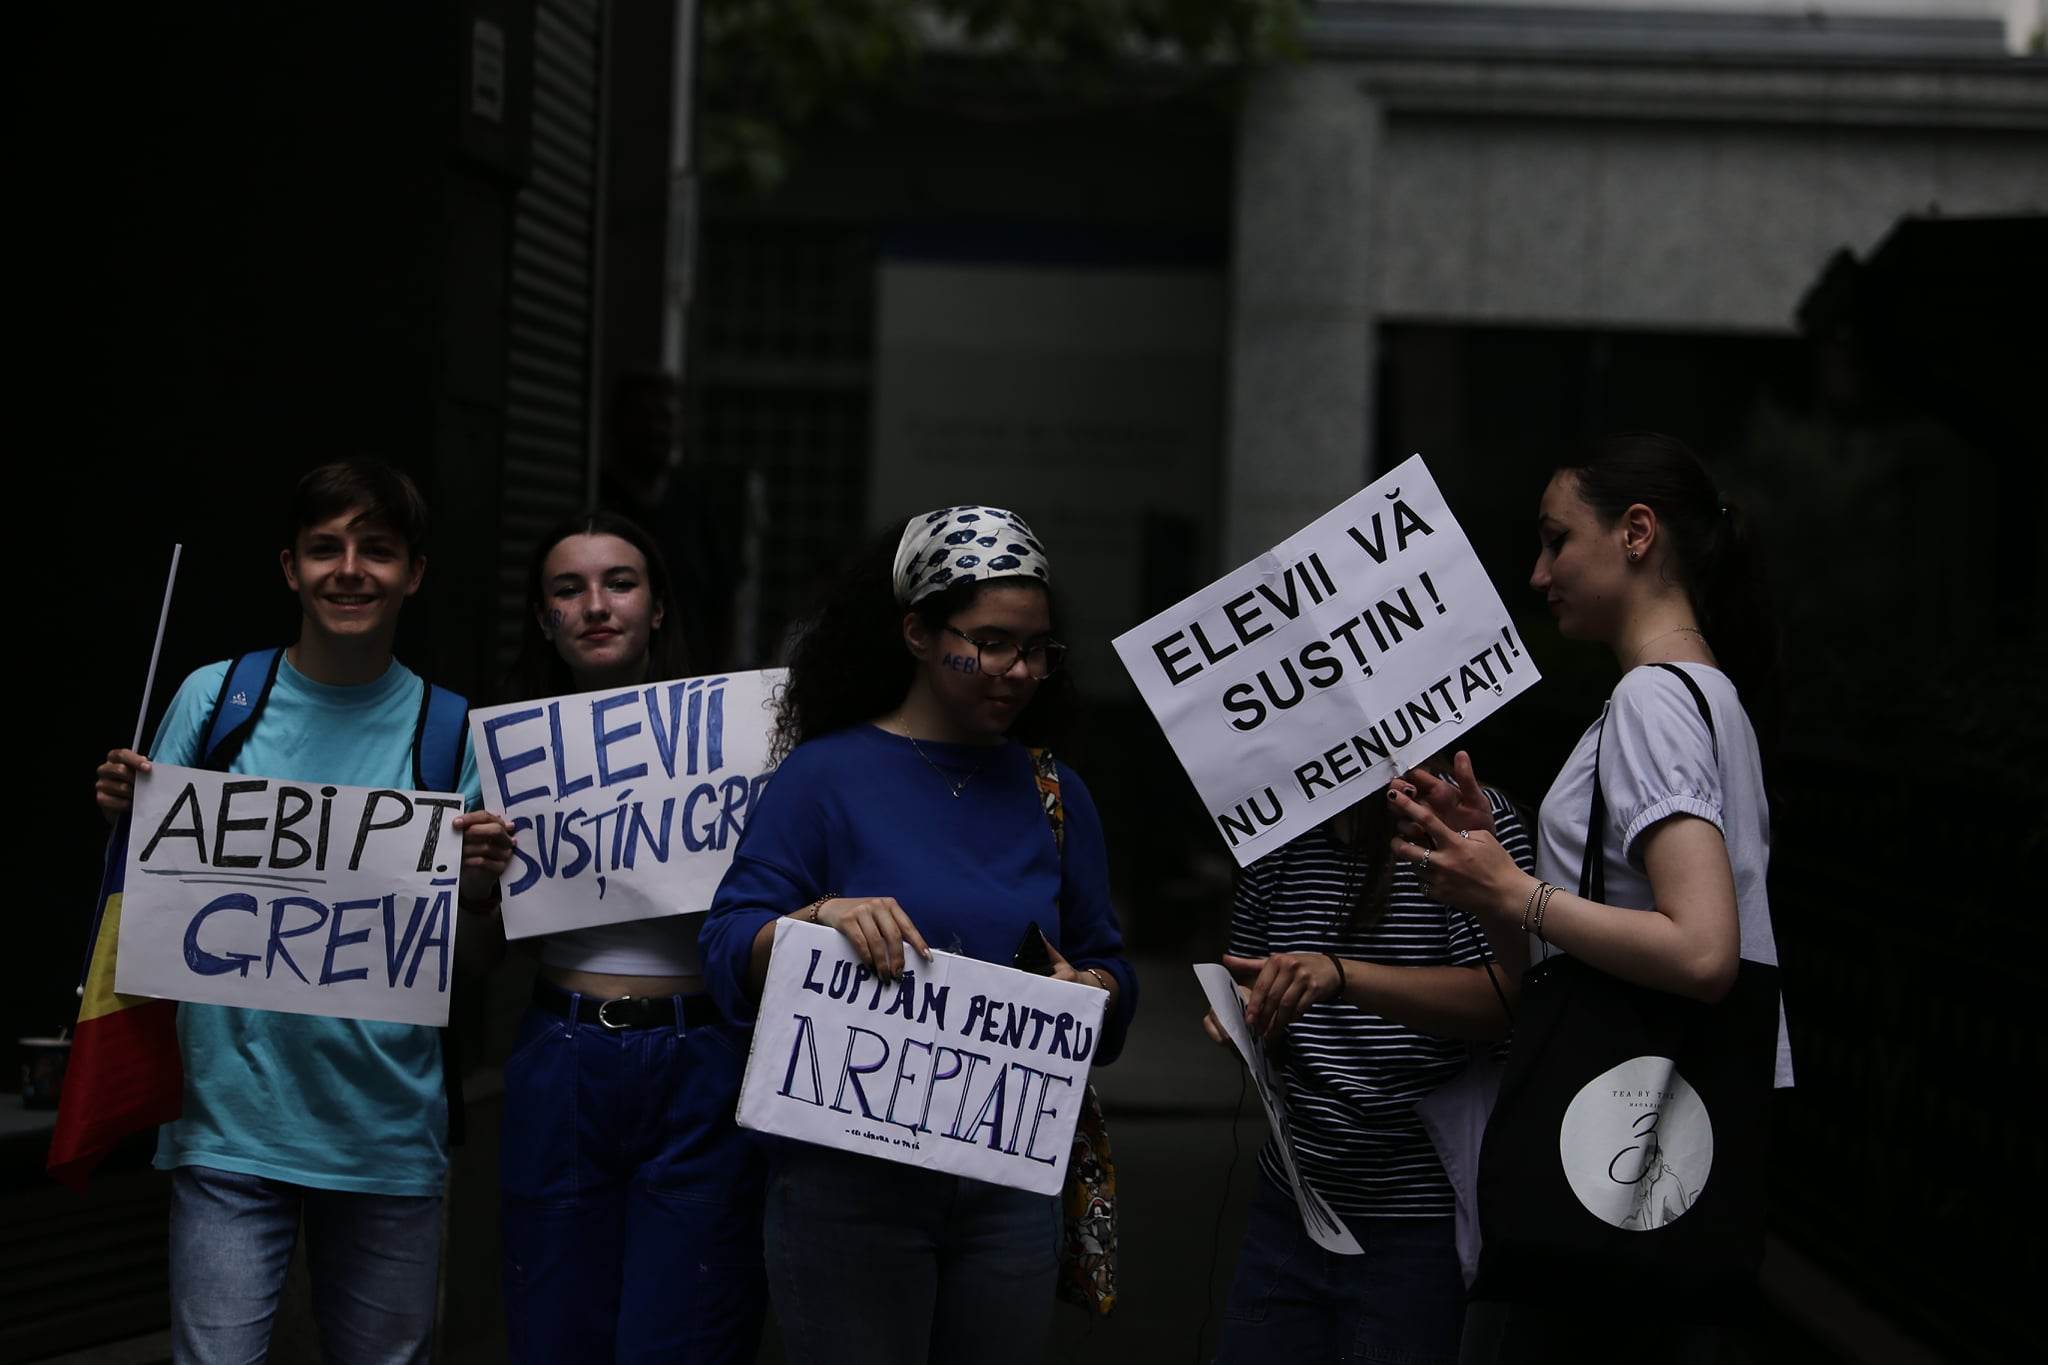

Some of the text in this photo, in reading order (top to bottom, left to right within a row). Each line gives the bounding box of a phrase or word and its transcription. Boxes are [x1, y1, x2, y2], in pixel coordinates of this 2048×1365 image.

[1152, 487, 1434, 685] ELEVII VĂ
[1223, 586, 1424, 731] SUSȚIN
[1218, 626, 1520, 845] NU RENUNȚAȚI!
[348, 790, 461, 872] PT.
[961, 995, 1092, 1061] PENTRU
